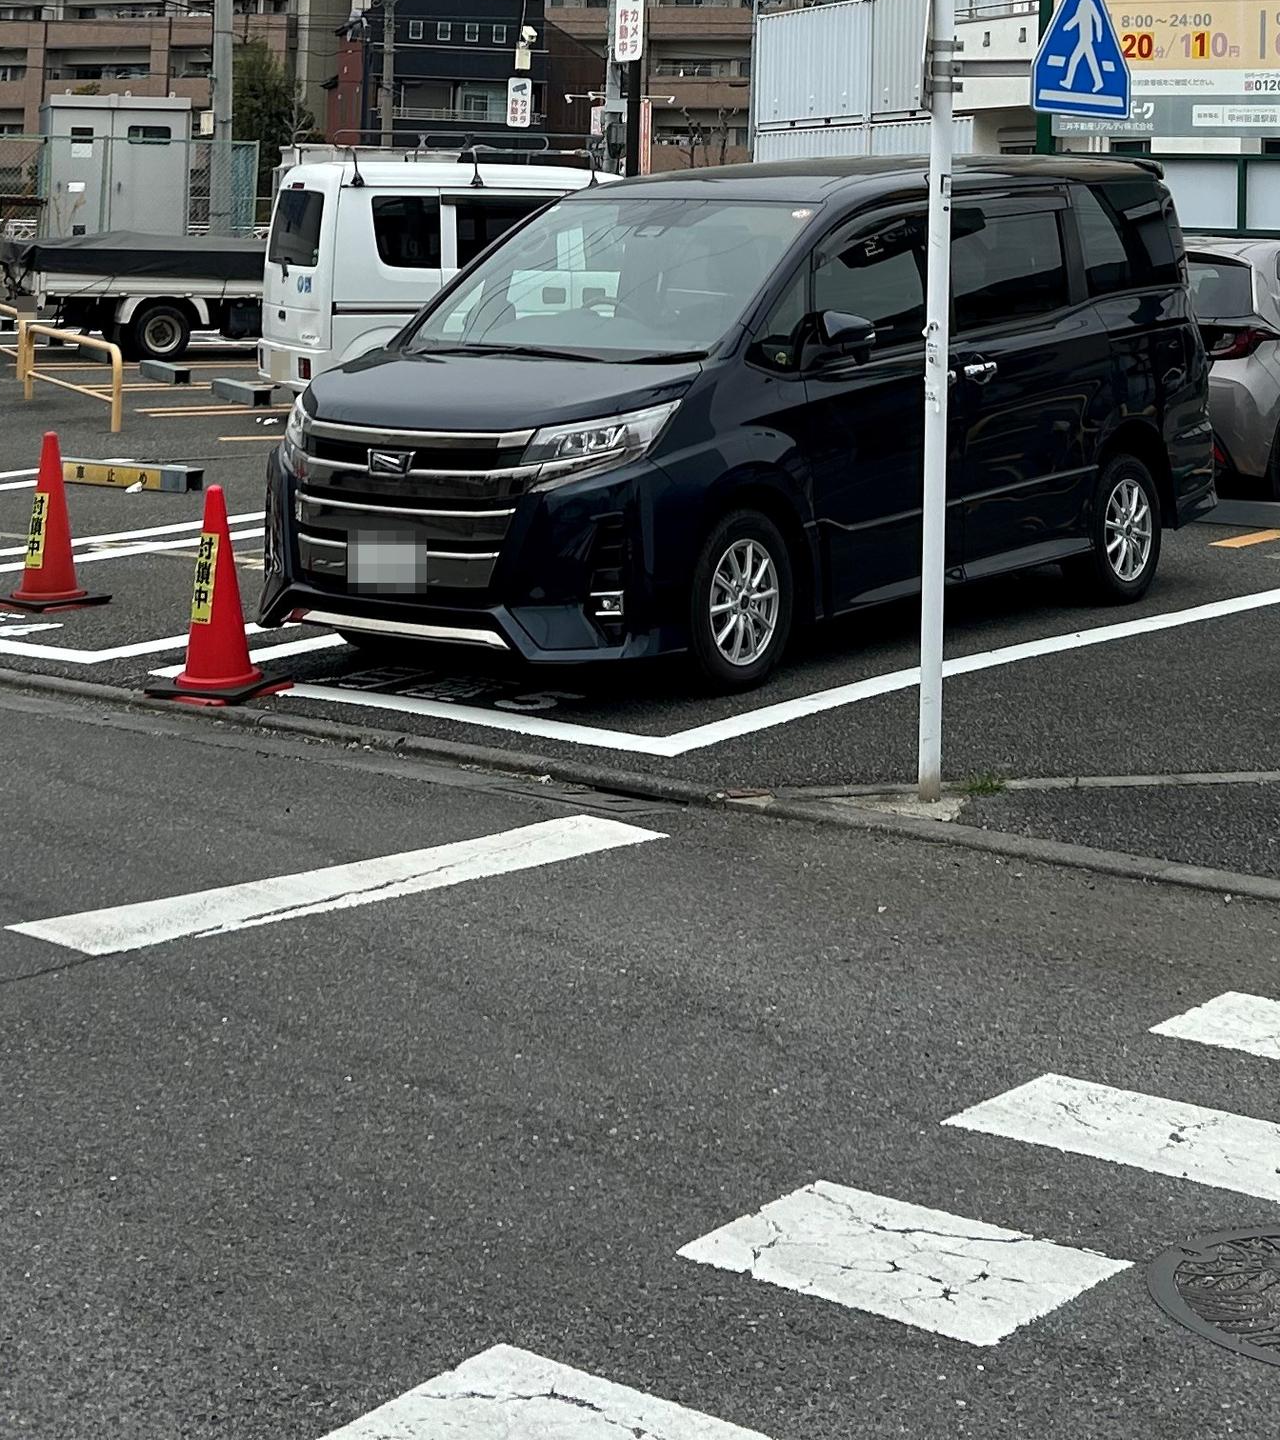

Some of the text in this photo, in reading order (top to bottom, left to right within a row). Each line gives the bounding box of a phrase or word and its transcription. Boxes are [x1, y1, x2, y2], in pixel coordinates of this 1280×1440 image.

[618, 8, 629, 56] 作動中
[629, 8, 639, 55] カメラ
